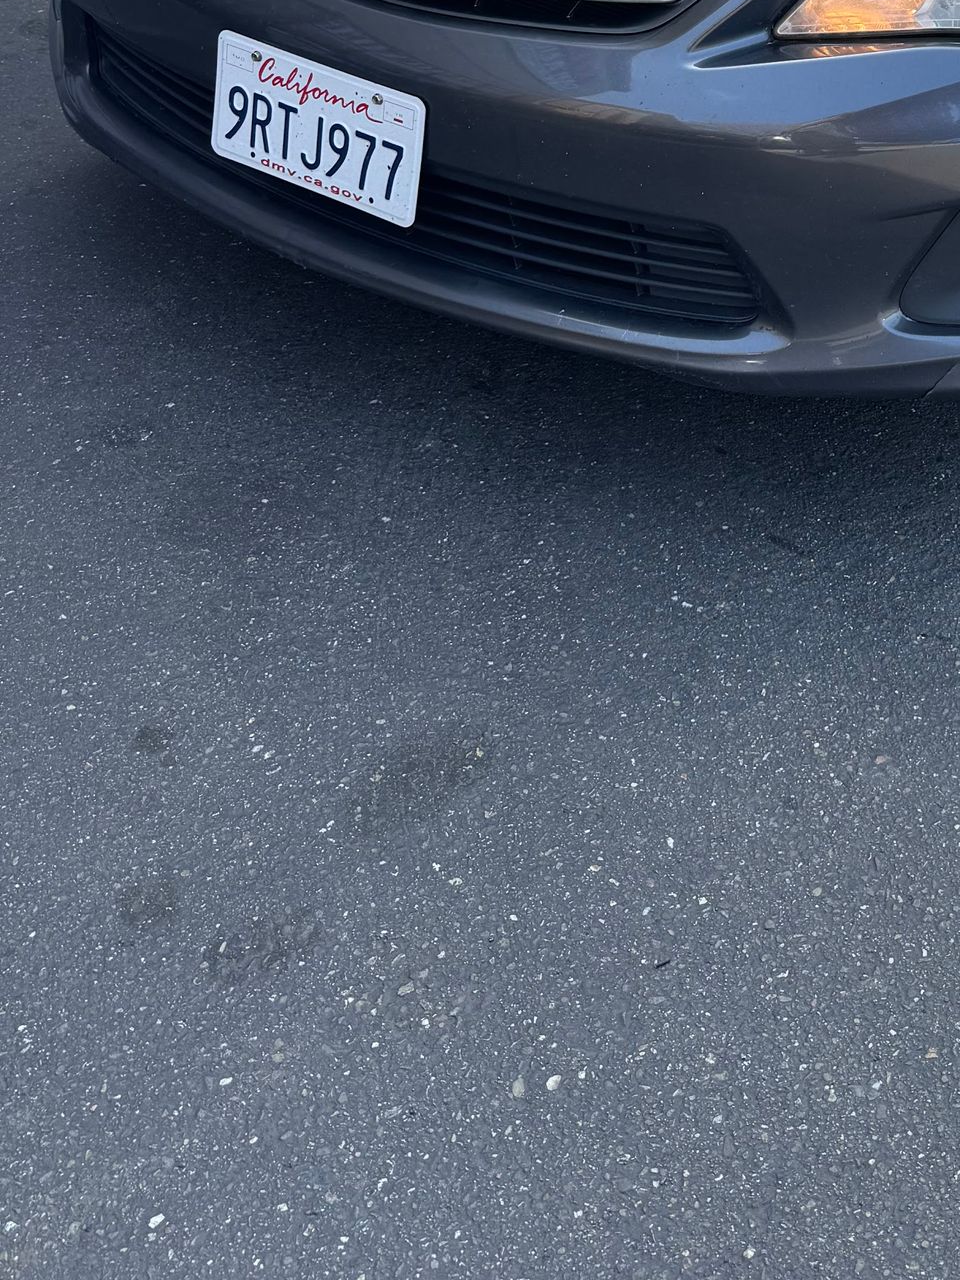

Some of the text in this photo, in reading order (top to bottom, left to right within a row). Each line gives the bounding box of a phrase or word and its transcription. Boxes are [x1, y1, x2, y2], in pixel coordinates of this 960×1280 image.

[258, 57, 384, 124] California
[224, 85, 405, 201] 9RTJ977
[260, 157, 363, 203] dmv.ca.gov
